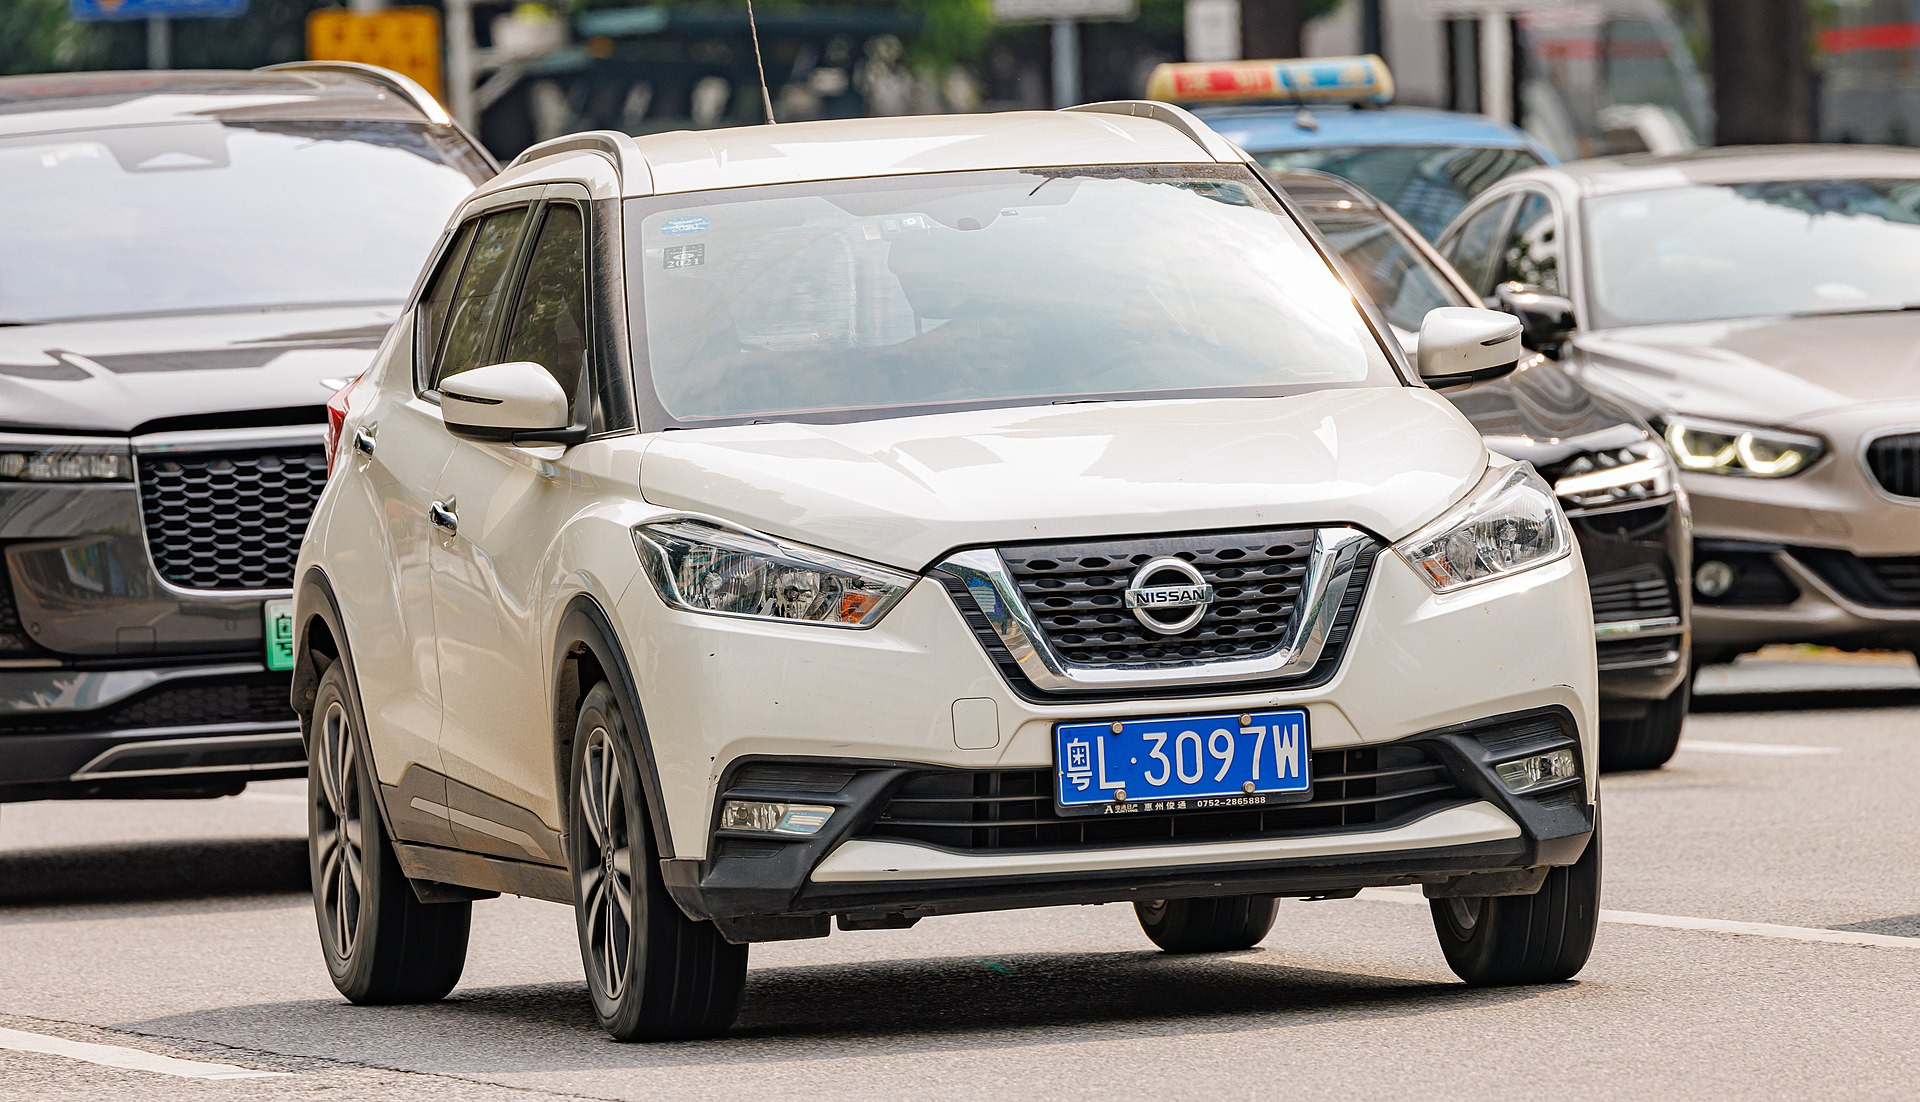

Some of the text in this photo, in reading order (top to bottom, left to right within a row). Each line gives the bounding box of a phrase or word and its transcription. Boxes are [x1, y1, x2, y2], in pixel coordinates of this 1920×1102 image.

[667, 257, 699, 269] 2021
[1136, 589, 1205, 604] NISSAN
[1144, 801, 1187, 812] 惠州俊通
[1197, 796, 1266, 808] 0752-2865888
